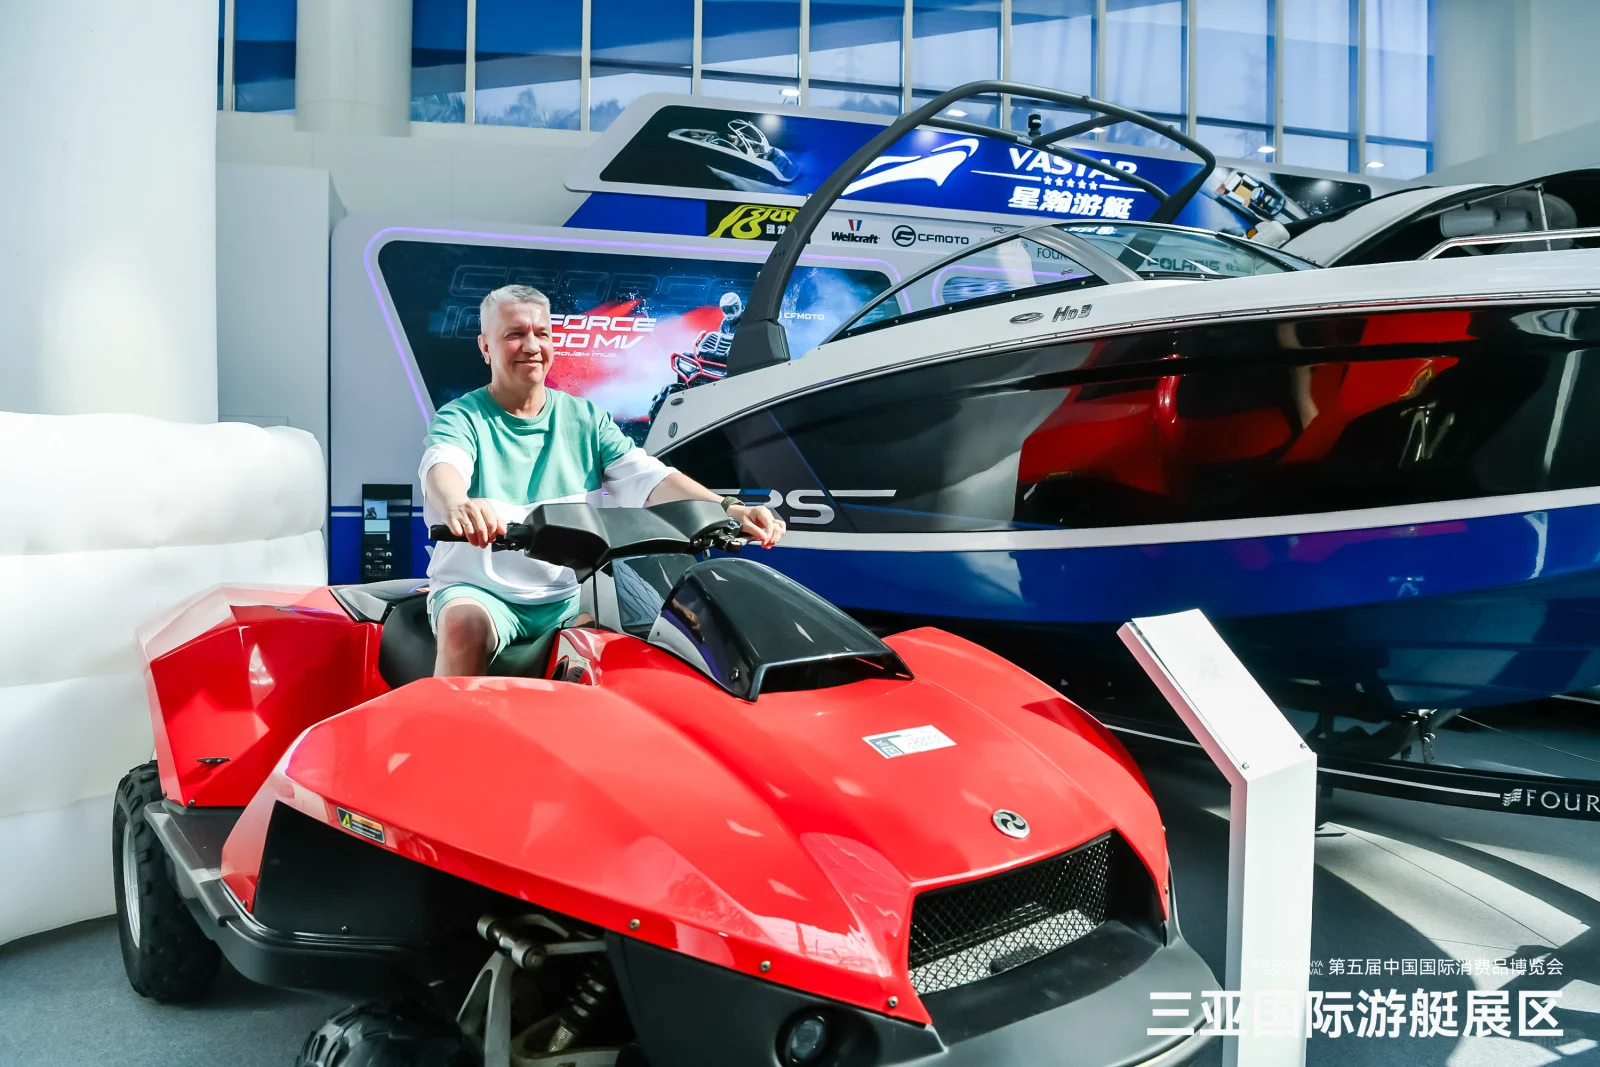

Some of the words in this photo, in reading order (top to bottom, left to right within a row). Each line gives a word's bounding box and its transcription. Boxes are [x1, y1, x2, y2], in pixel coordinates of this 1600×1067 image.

[1008, 186, 1135, 219] 星瀚游艇
[831, 231, 878, 244] Wellcraft
[917, 233, 970, 245] CFMOTO
[783, 312, 825, 320] CFMOTO
[593, 334, 645, 350] MV
[1526, 788, 1600, 814] FOUR
